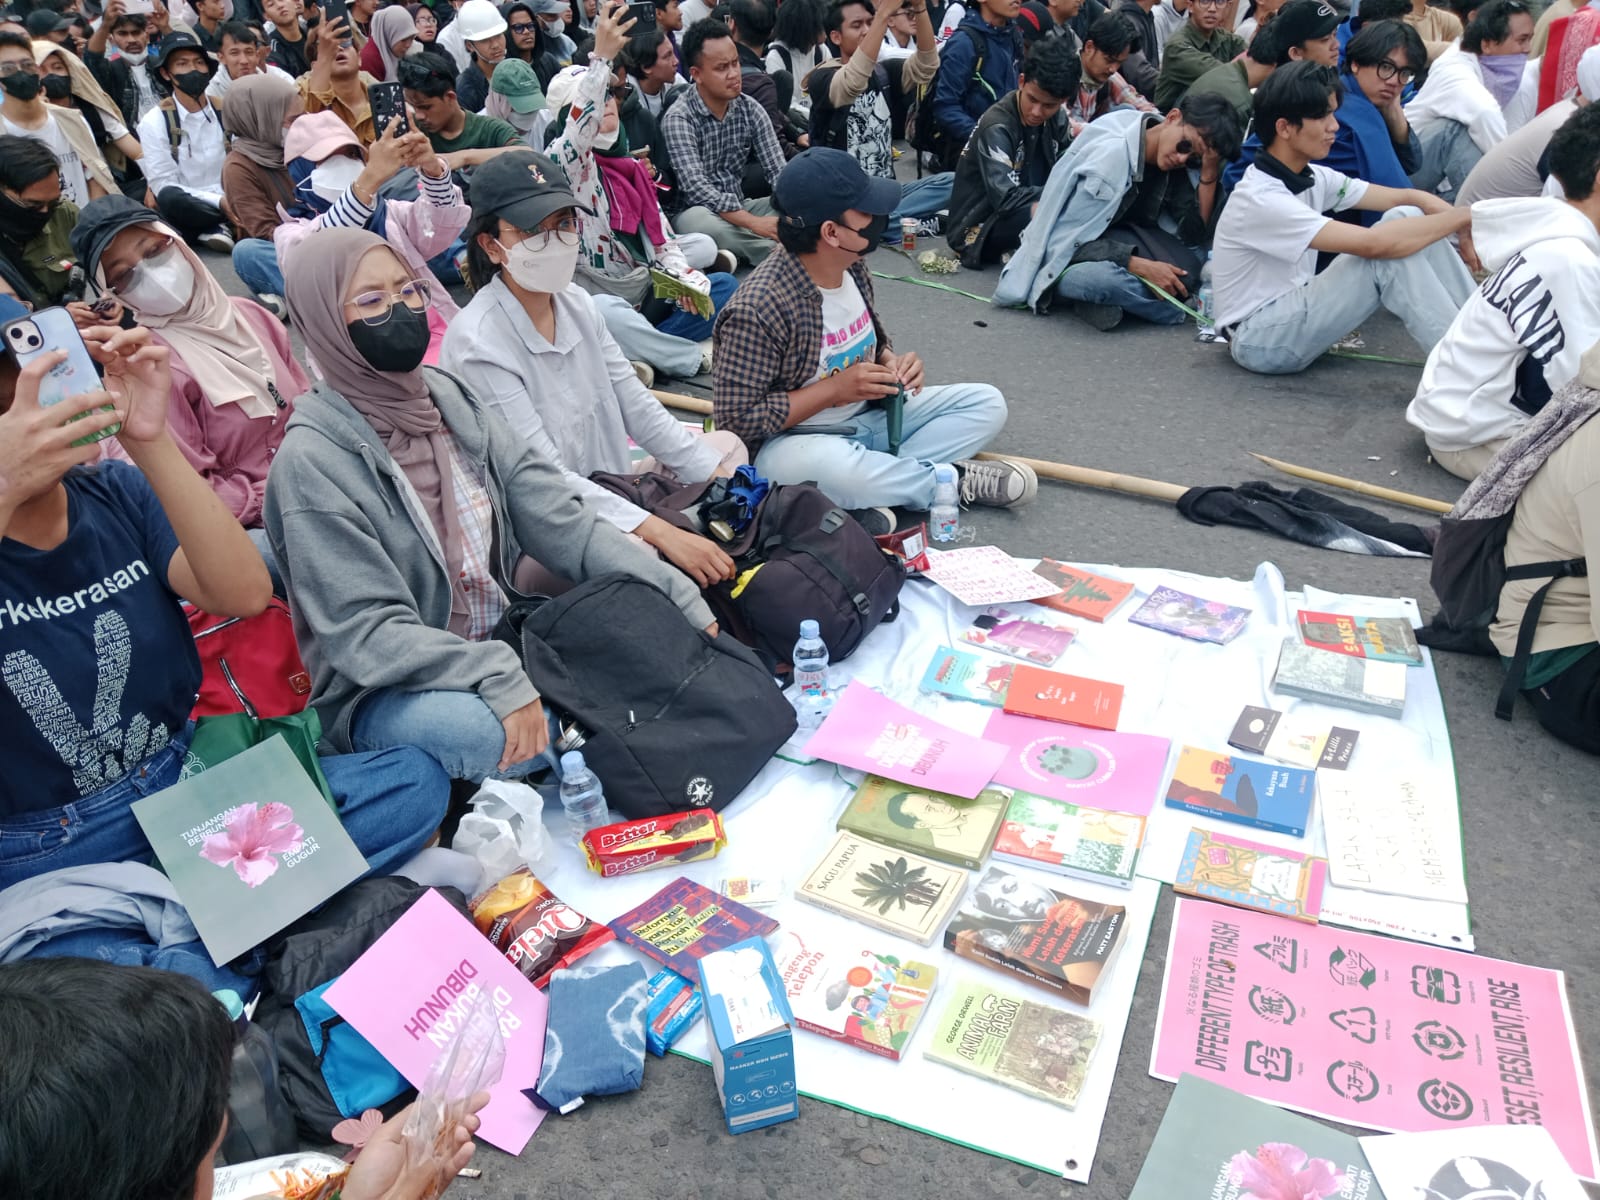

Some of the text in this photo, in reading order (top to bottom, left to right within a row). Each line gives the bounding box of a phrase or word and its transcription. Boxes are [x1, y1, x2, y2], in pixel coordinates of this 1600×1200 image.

[1336, 617, 1359, 653] SAKSI
[53, 712, 121, 751] perdamaian
[911, 738, 946, 776] DIBUNUH
[180, 805, 238, 841] TUNJANGAN
[187, 813, 238, 847] BERBUNGA
[602, 820, 657, 848] Better
[282, 836, 316, 861] EMPATI
[286, 842, 321, 868] GUGUR
[604, 850, 657, 877] Better
[817, 867, 839, 891] SAGU
[837, 843, 859, 871] PAPUA
[505, 904, 587, 965] Qtela
[635, 906, 683, 937] Reformasi
[647, 915, 687, 942] yang Tak
[655, 926, 689, 947] Pernah
[1096, 914, 1120, 955] MATT EASTON
[664, 943, 680, 954] Itu
[1036, 937, 1057, 962] Lelah
[783, 948, 812, 988] ongeng
[787, 952, 825, 998] Telepon
[404, 959, 478, 1041] DIBUNUH
[1195, 920, 1240, 1072] DIFFERENT TYPE OF TRASH
[1259, 995, 1284, 1016] 紙
[427, 983, 480, 1048] BUKAN
[946, 995, 974, 1044] GEORGE ORWELL
[987, 998, 1020, 1039] FARM
[957, 1010, 993, 1060] ANIMAL
[1487, 977, 1544, 1125] ESET, RESILIENT, RISE
[1257, 1045, 1280, 1072] プラ
[1347, 1060, 1364, 1093] スチール
[1211, 1161, 1232, 1200] JANGAN
[1340, 1165, 1358, 1199] EMPATI
